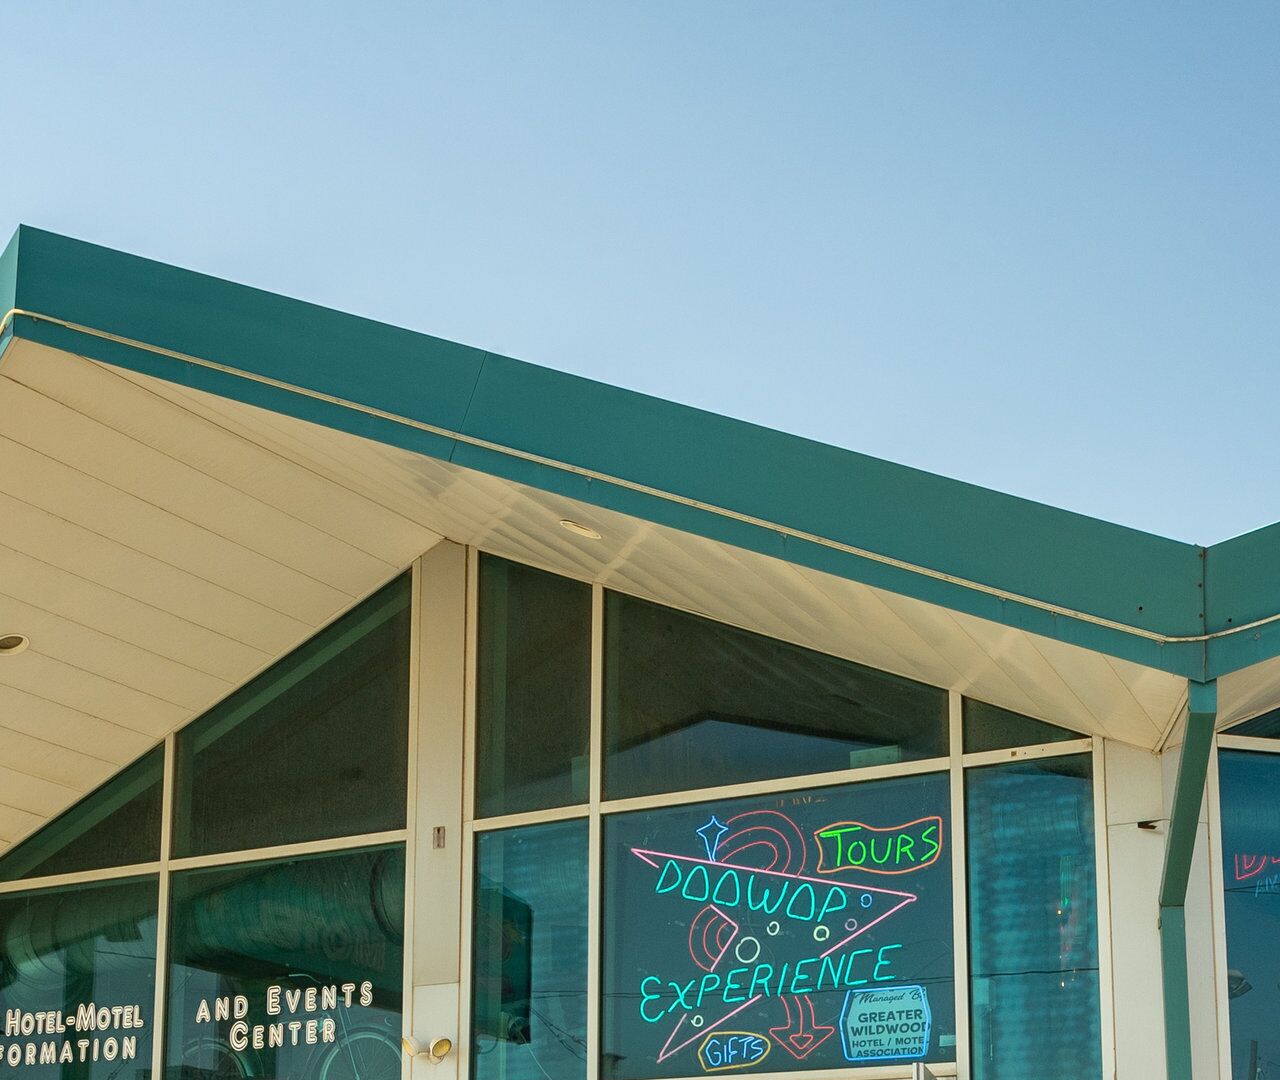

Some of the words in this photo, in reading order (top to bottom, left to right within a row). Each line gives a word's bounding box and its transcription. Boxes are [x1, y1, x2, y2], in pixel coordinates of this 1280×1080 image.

[820, 824, 939, 868] TOURS
[655, 858, 848, 922] DOOWOP
[639, 944, 904, 1024] EXPERIENCE
[854, 992, 906, 1005] Managed
[195, 994, 250, 1024] AND
[266, 980, 374, 1016] EVENTS
[858, 1008, 923, 1023] GREATER
[5, 1002, 145, 1037] HOTEL-MOTEL
[228, 1017, 337, 1052] CENTER
[850, 1021, 931, 1037] WILDWOOD
[703, 1036, 765, 1068] GIFTS
[852, 1039, 885, 1048] HOTEL
[855, 1046, 924, 1058] ASSOCIATION
